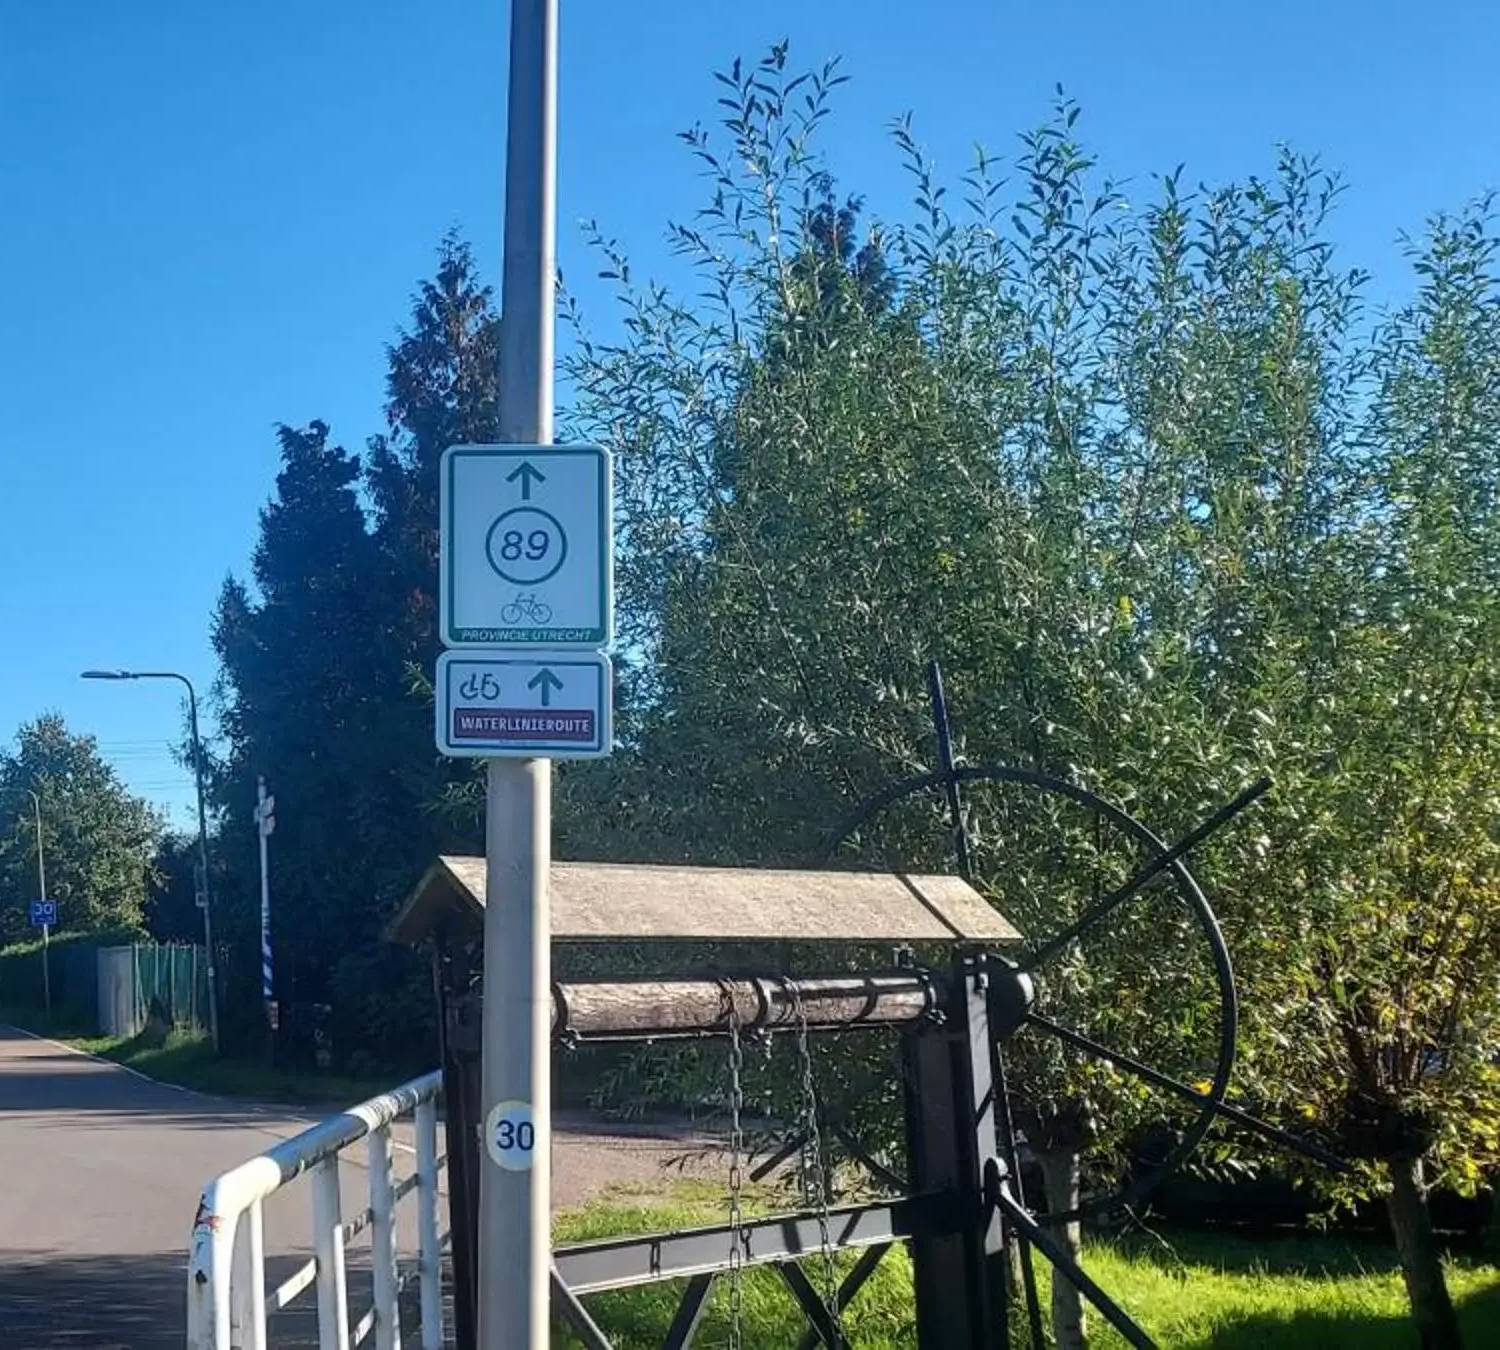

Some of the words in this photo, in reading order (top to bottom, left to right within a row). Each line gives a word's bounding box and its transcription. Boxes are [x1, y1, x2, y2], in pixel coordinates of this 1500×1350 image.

[501, 531, 549, 560] 89
[461, 629, 529, 641] PROVINCIE
[530, 630, 592, 641] UTRECHT
[460, 717, 589, 732] WATERLINIEROUTE
[35, 903, 53, 915] 30
[496, 1120, 535, 1150] 30
